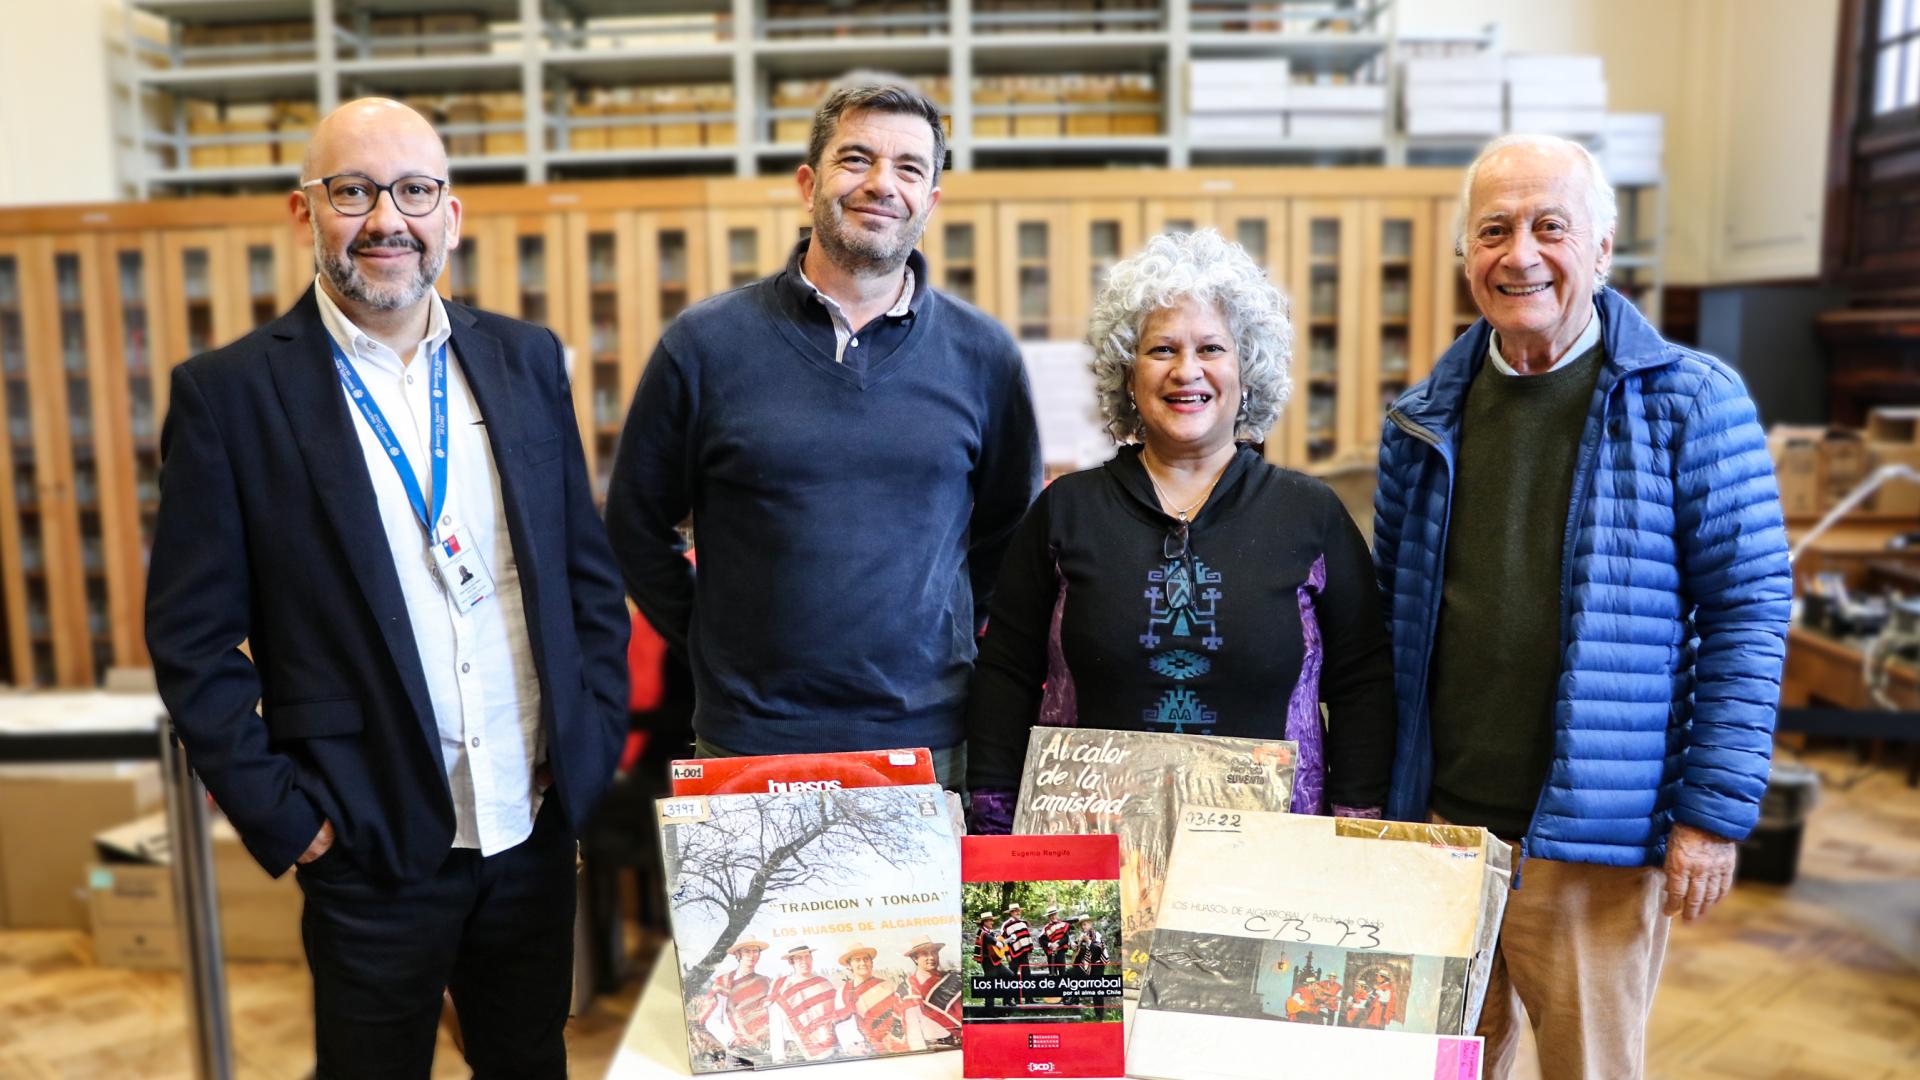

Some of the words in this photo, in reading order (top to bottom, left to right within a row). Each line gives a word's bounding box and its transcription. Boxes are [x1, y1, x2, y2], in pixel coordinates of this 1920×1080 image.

[1039, 732, 1071, 768] Al
[1072, 737, 1131, 764] calor
[674, 768, 702, 779] A-001
[1036, 764, 1069, 786] de
[1076, 764, 1101, 789] la
[768, 780, 842, 793] huasos
[667, 804, 694, 815] 3797
[1031, 792, 1131, 815] amistad
[865, 897, 874, 907] Y
[1190, 902, 1228, 914] HUASOS
[1231, 906, 1243, 916] DE
[772, 927, 798, 938] LOS
[802, 922, 854, 936] HUASOS
[858, 921, 876, 932] DE
[973, 978, 992, 990] Los
[994, 978, 1036, 990] Huasos
[1038, 978, 1056, 989] de
[1058, 977, 1121, 991] Algarrobal
[1106, 988, 1122, 996] Chile
